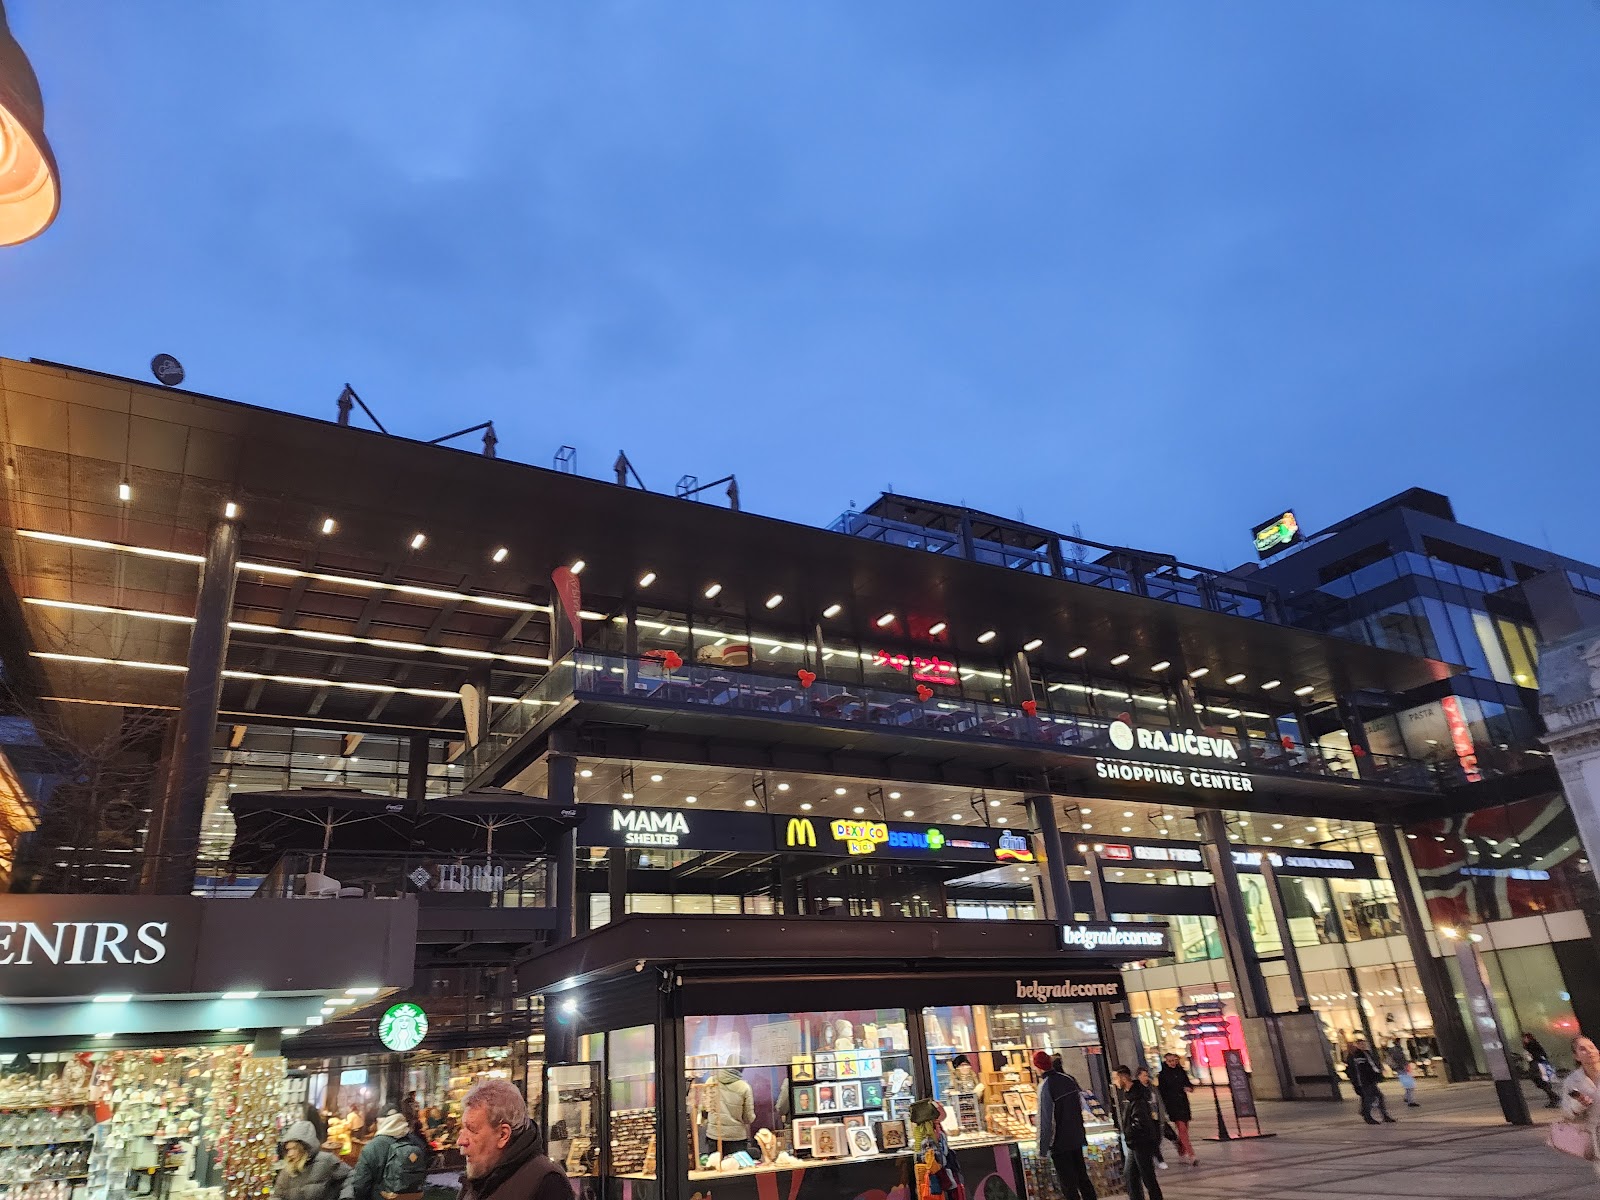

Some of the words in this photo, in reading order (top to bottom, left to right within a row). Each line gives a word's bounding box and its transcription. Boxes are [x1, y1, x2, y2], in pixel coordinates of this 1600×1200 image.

[1408, 708, 1435, 720] PASTA
[1136, 728, 1238, 760] RAJIĆEVA
[1096, 762, 1185, 786] SHOPPING
[1190, 772, 1253, 792] CENTER
[612, 809, 690, 834] MAMA
[838, 824, 865, 838] DEXY
[869, 827, 884, 839] CO
[625, 832, 679, 846] SHELTER
[852, 842, 873, 852] kids
[888, 831, 929, 849] BENU
[1062, 925, 1164, 949] belgradecorner
[1015, 979, 1118, 1003] belgradecorner
